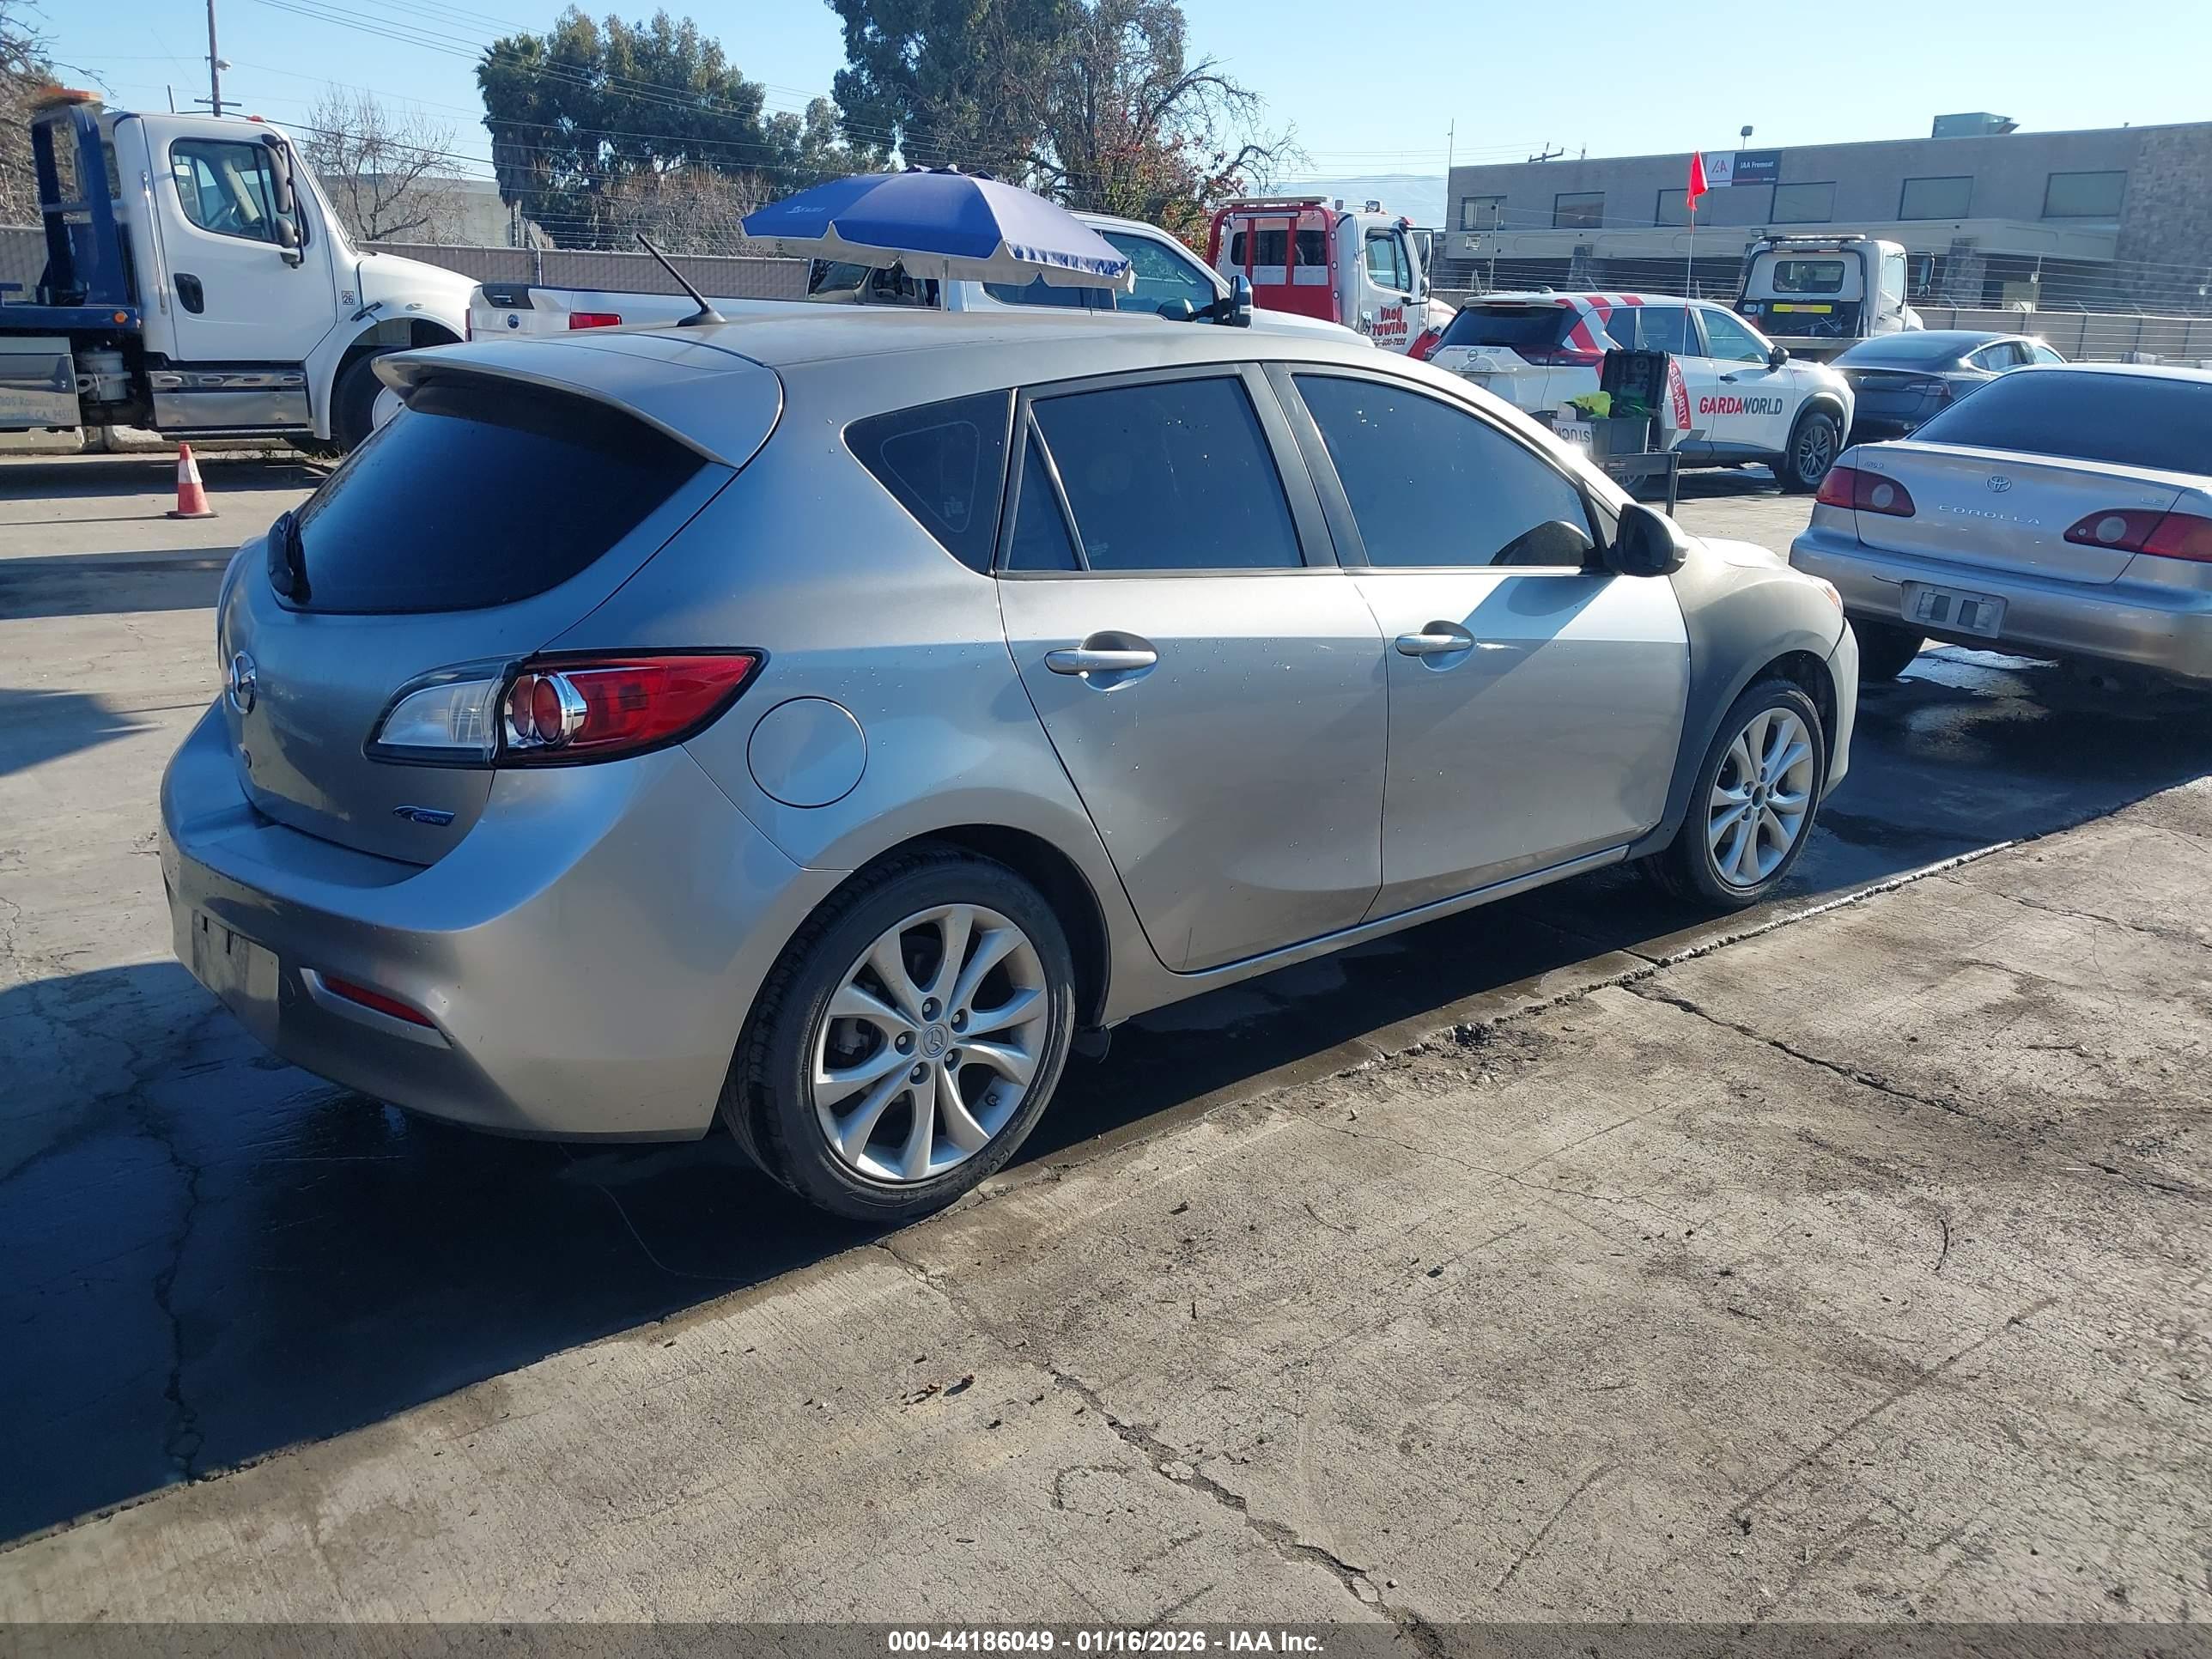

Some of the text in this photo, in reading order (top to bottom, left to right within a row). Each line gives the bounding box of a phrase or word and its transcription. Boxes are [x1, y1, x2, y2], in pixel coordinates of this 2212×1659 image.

[343, 295, 354, 304] 26
[1699, 396, 1784, 415] GARDAWORLD
[1938, 504, 2041, 526] COROLLA
